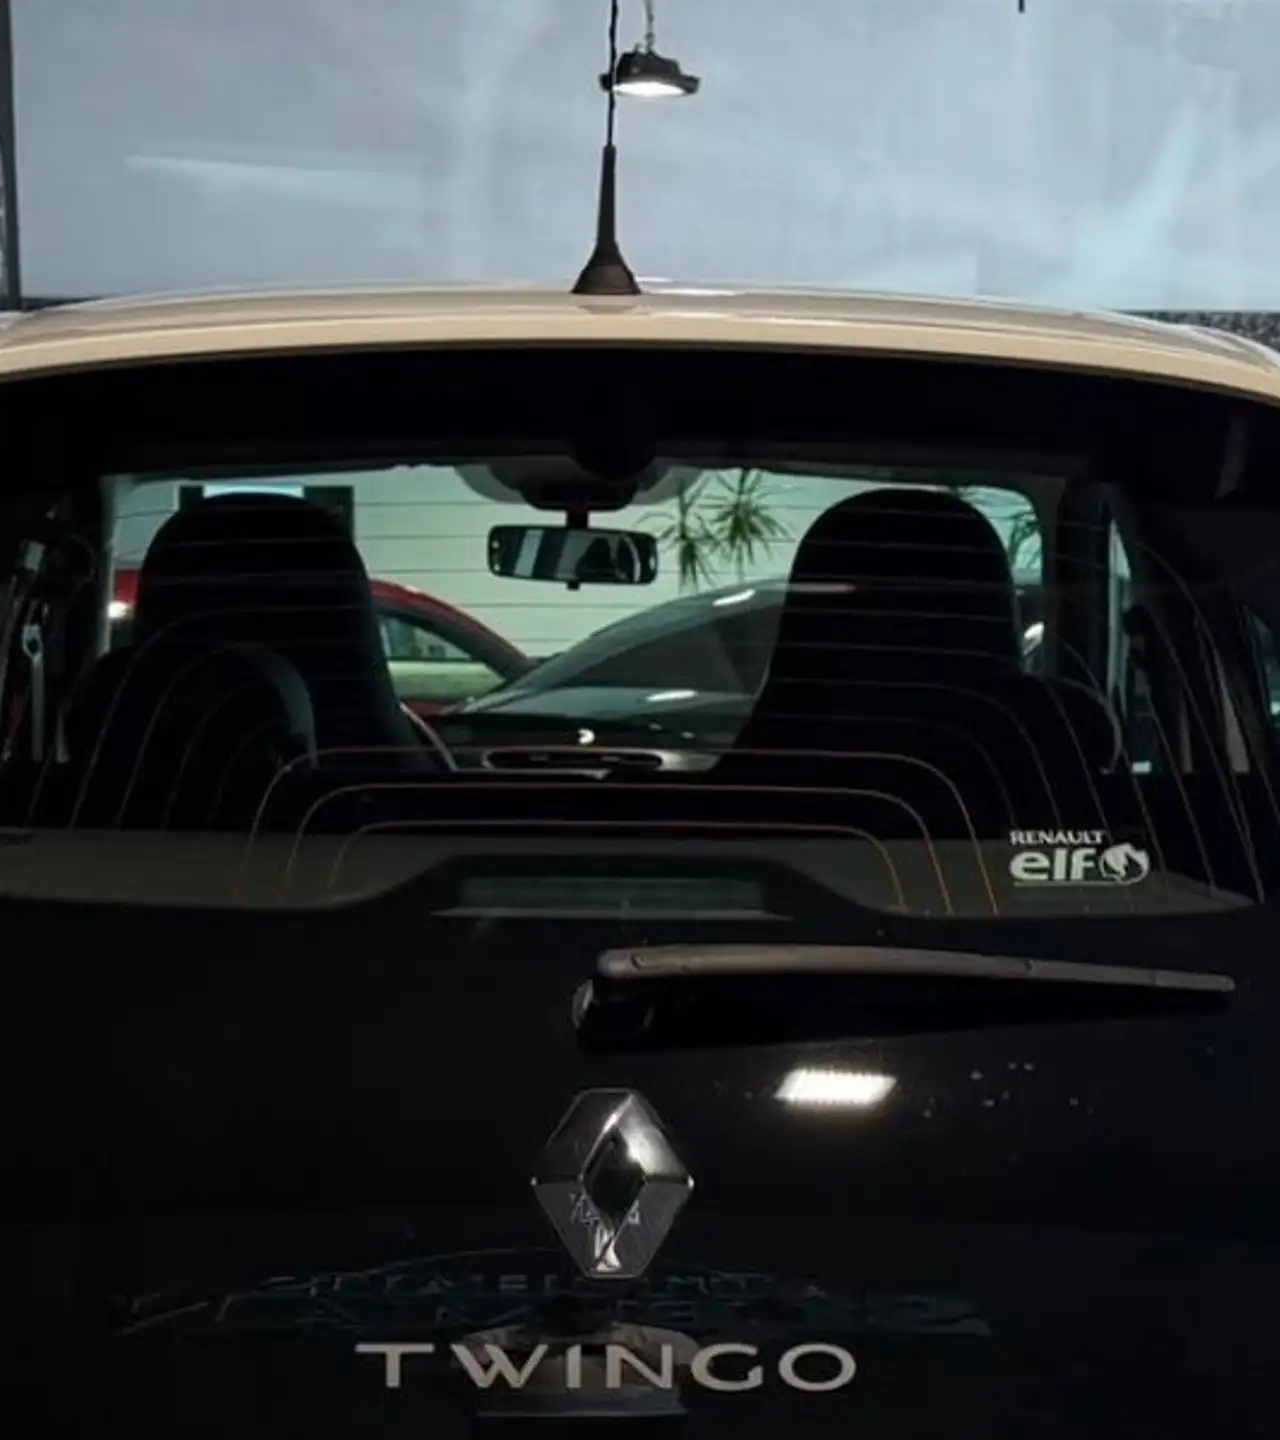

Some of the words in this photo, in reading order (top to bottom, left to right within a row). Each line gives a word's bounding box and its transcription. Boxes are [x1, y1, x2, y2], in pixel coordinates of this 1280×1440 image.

[1009, 829, 1106, 846] RENAULT
[1009, 847, 1097, 881] elf
[355, 1341, 858, 1394] TWINGO
